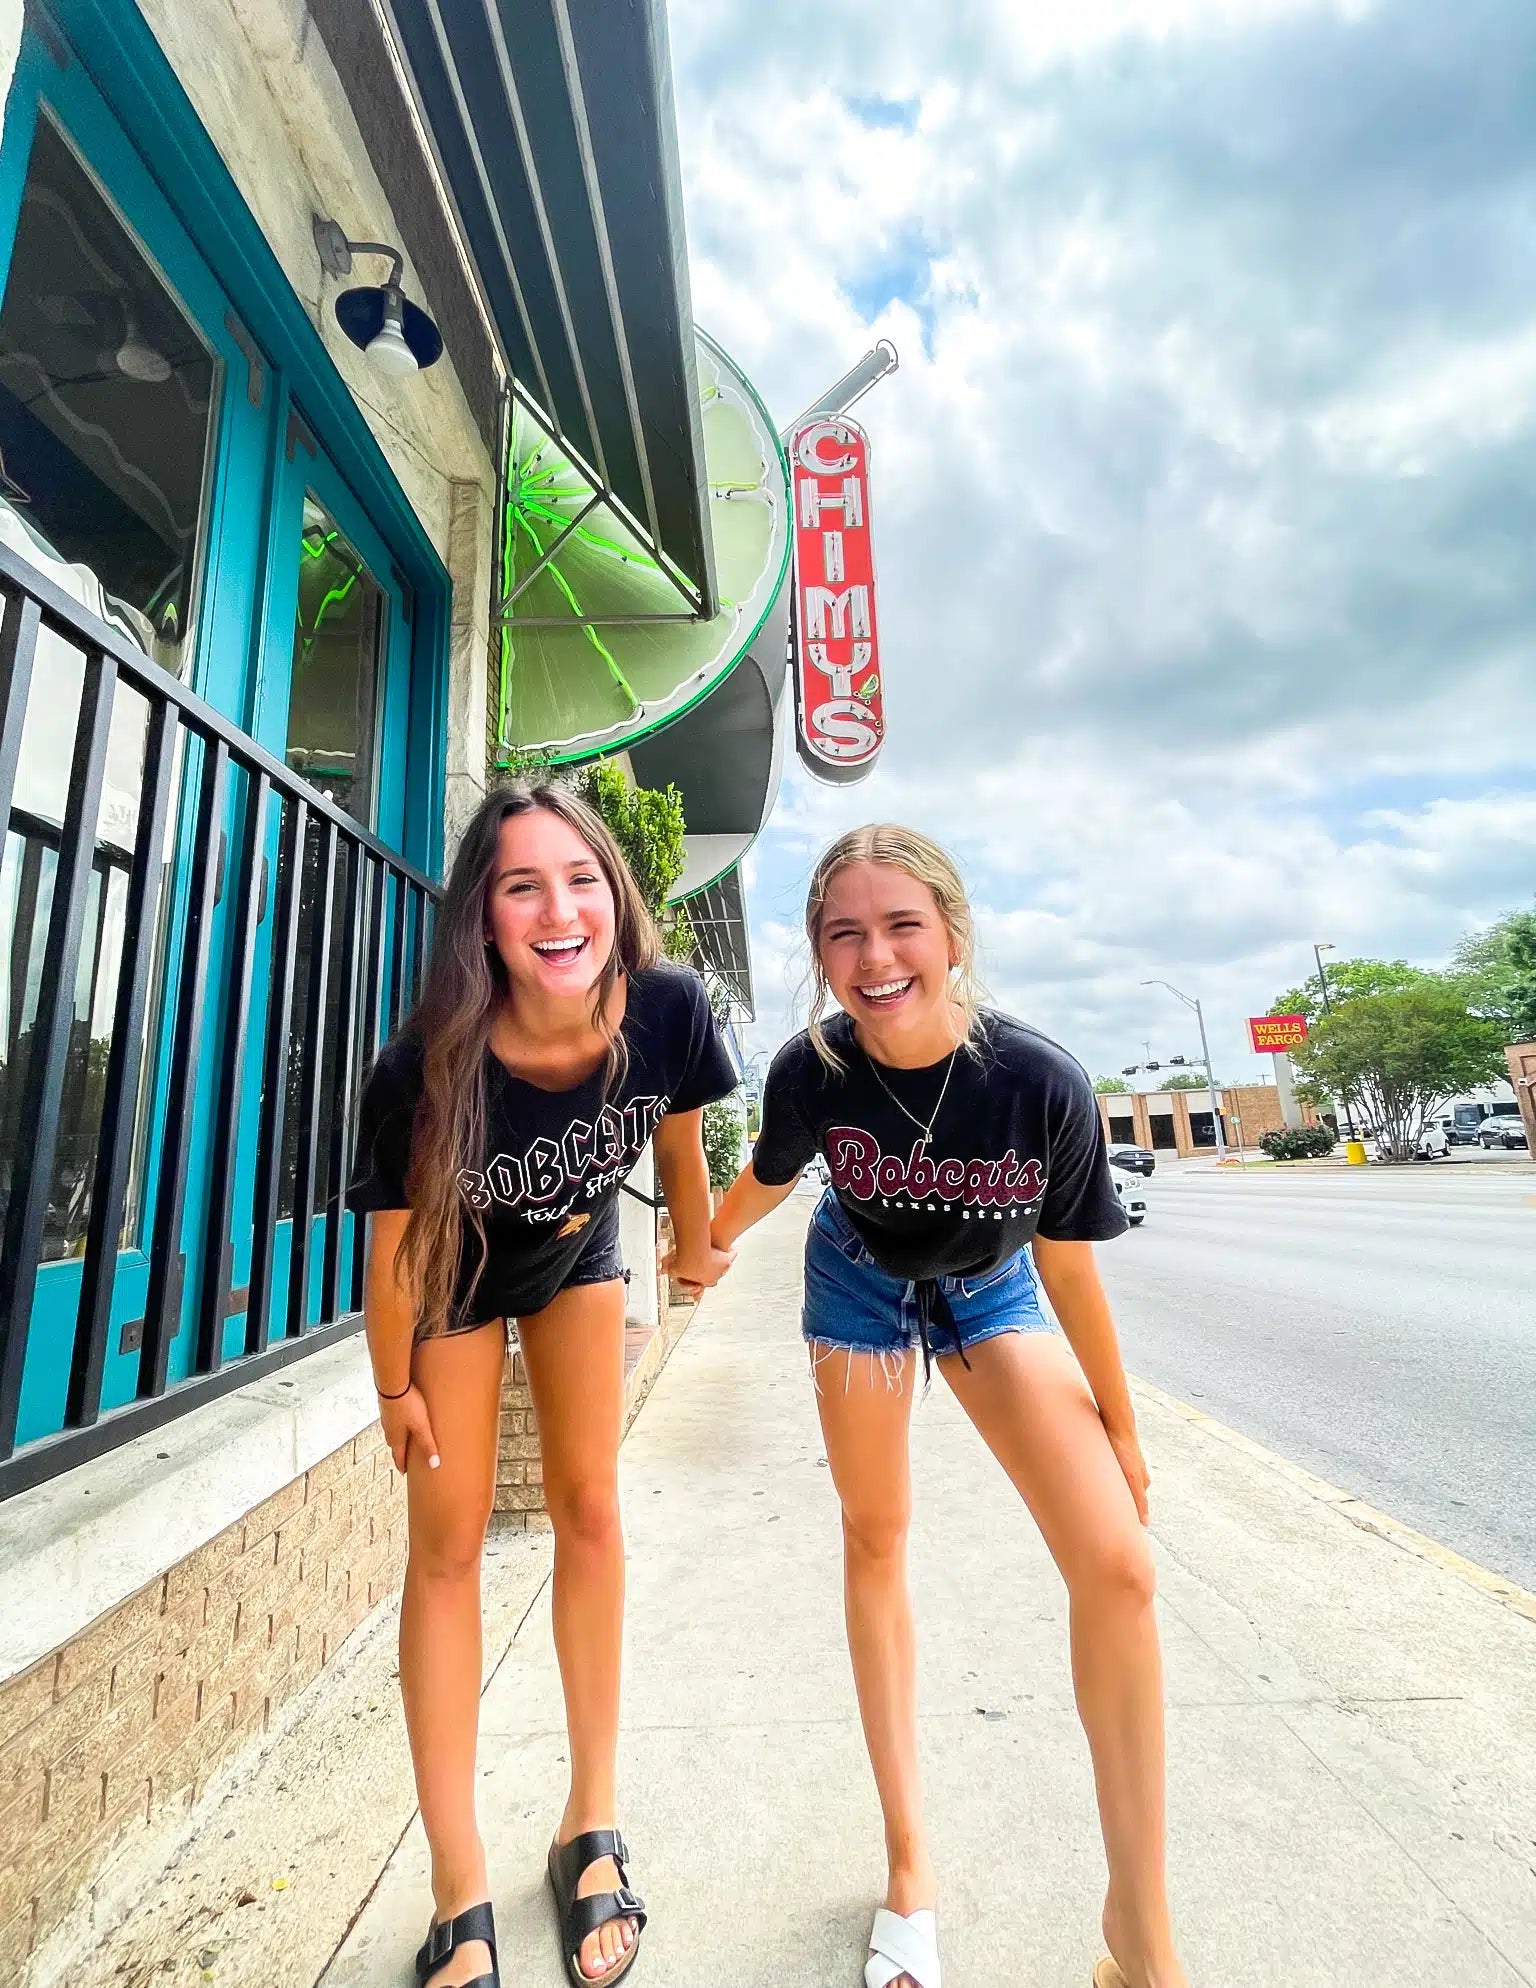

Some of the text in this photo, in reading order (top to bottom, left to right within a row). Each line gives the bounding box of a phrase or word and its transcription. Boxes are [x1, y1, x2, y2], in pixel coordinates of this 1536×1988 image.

[1253, 1022, 1302, 1034] WELLS
[1256, 1033, 1304, 1046] FARGO
[825, 1126, 1048, 1206] Bobcats
[585, 1164, 631, 1198] state
[881, 1198, 1036, 1220] texas state
